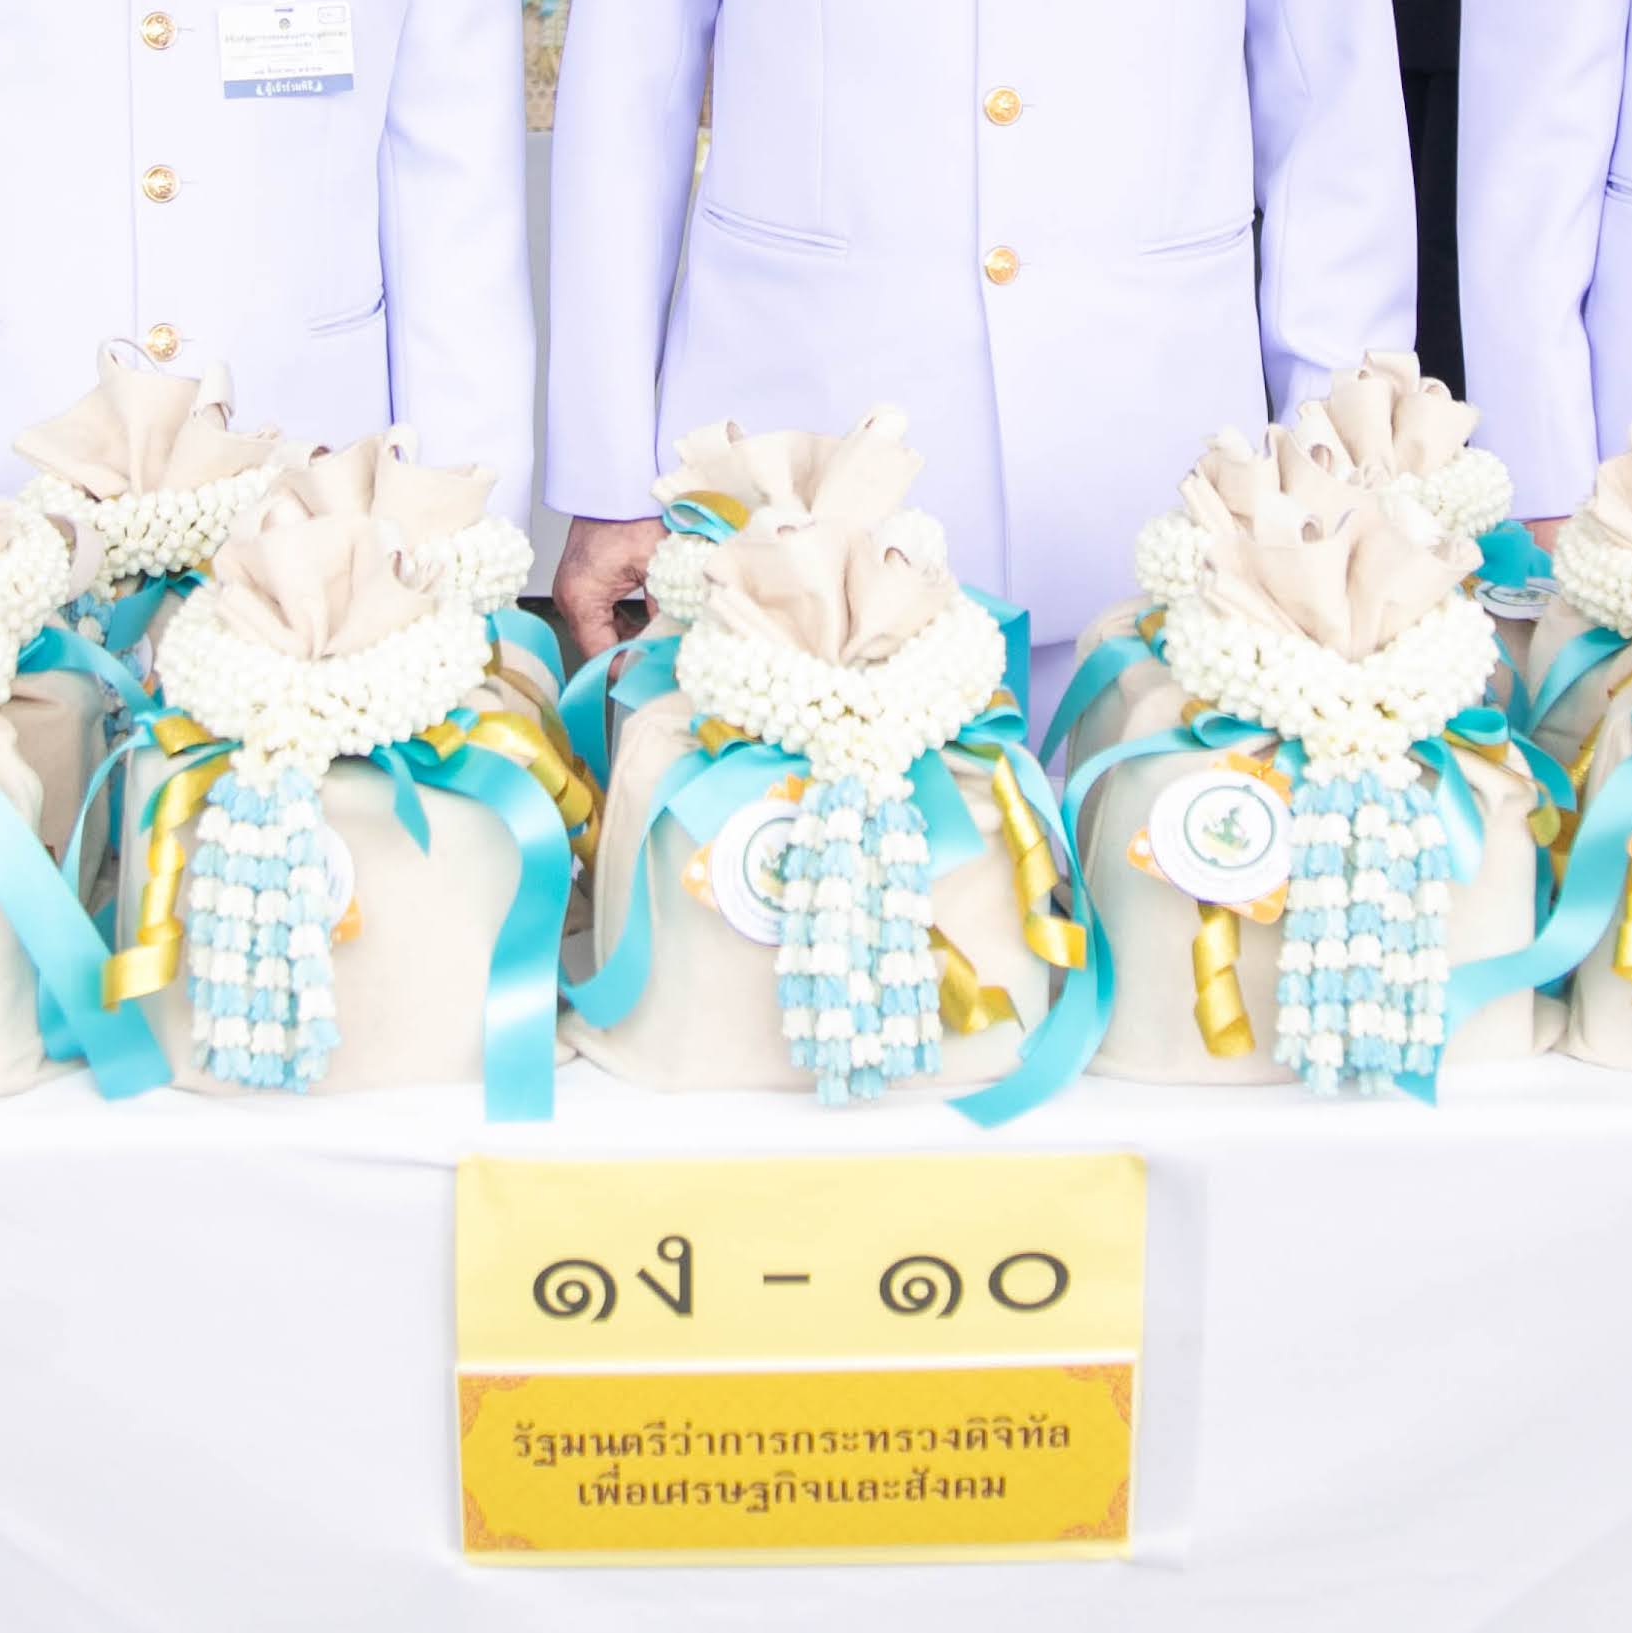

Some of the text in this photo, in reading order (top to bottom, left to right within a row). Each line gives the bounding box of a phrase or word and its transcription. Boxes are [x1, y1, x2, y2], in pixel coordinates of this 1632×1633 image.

[533, 1235, 1069, 1322] ๑ง - ๑๐
[513, 1413, 1070, 1467] รัฐมนตรีว่าการกระทรวงดิจิทัล
[578, 1462, 1007, 1513] เพื่อเศรษฐกิจและสังคม
